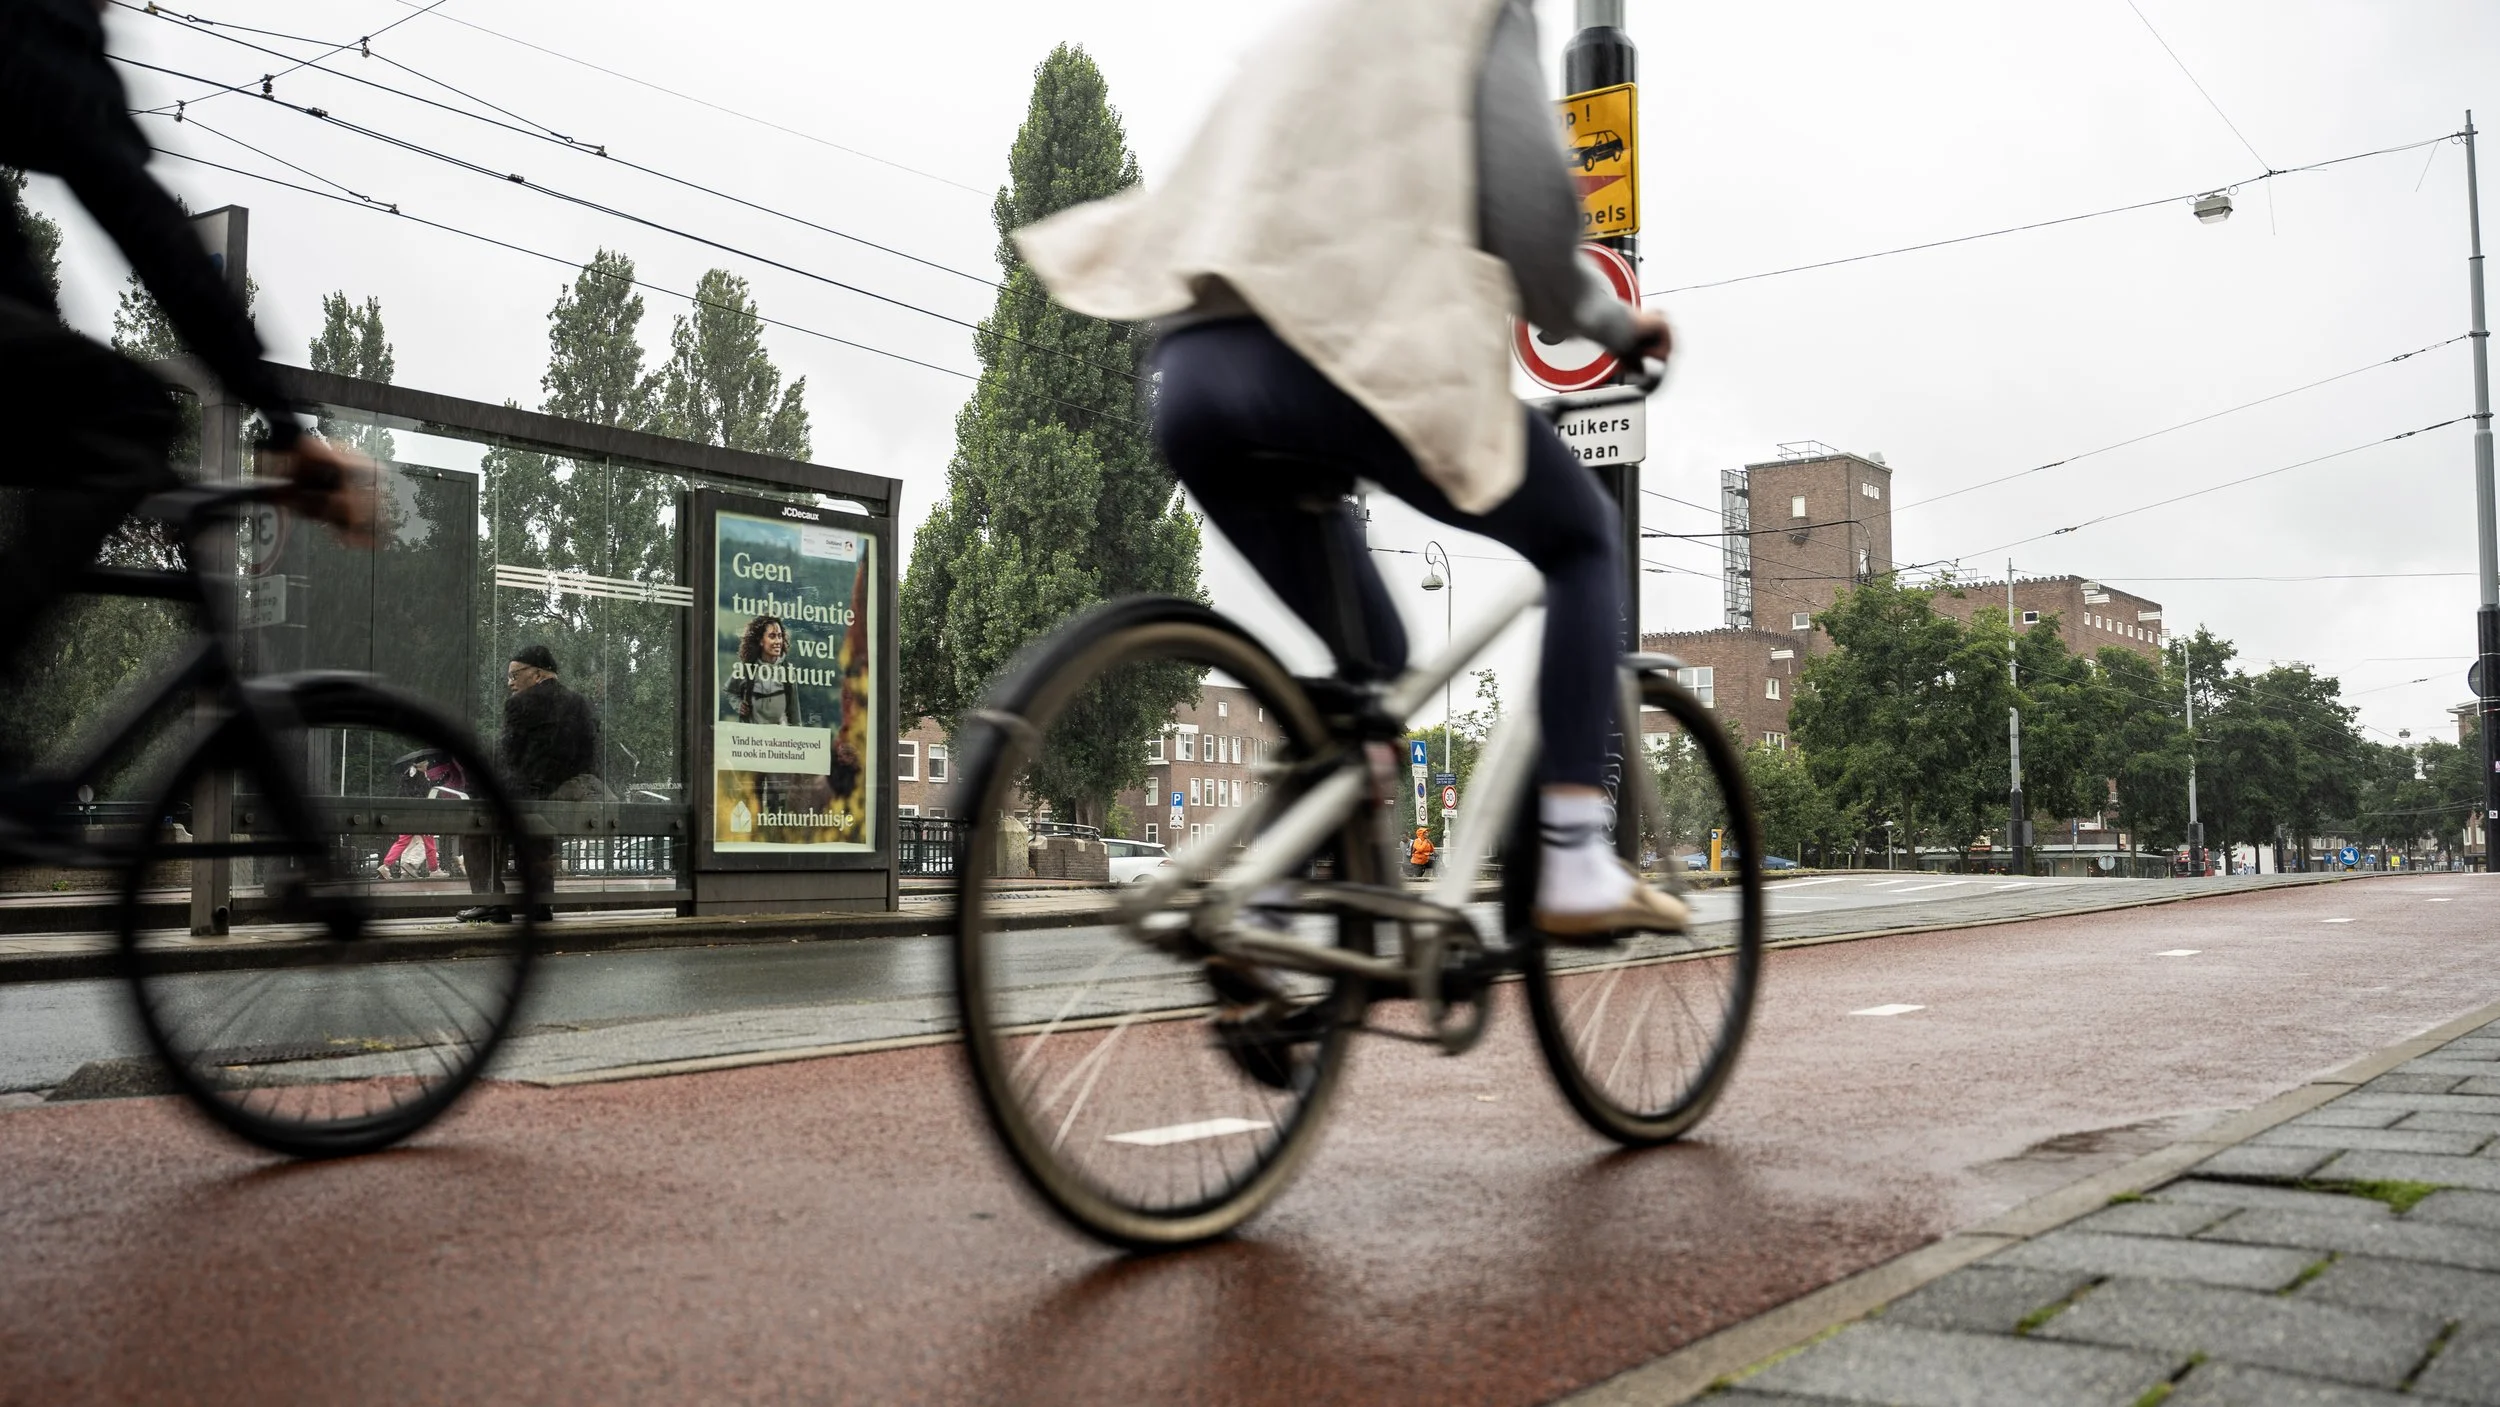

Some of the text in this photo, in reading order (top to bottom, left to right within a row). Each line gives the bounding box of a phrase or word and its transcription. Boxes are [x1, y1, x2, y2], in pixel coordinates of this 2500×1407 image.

[1557, 418, 1630, 437] ruikers
[1571, 445, 1619, 460] baan
[781, 506, 820, 521] JCDecaux
[732, 552, 793, 584] Geen
[732, 592, 856, 627] turbulentie
[797, 636, 835, 660] wel
[732, 660, 835, 687] avontuur
[731, 735, 821, 750] Vind het vakantiegevoel
[731, 749, 805, 760] nu ook in Duitsland
[1174, 793, 1181, 805] P
[1445, 792, 1455, 802] 30
[756, 806, 853, 831] natuurhuisje
